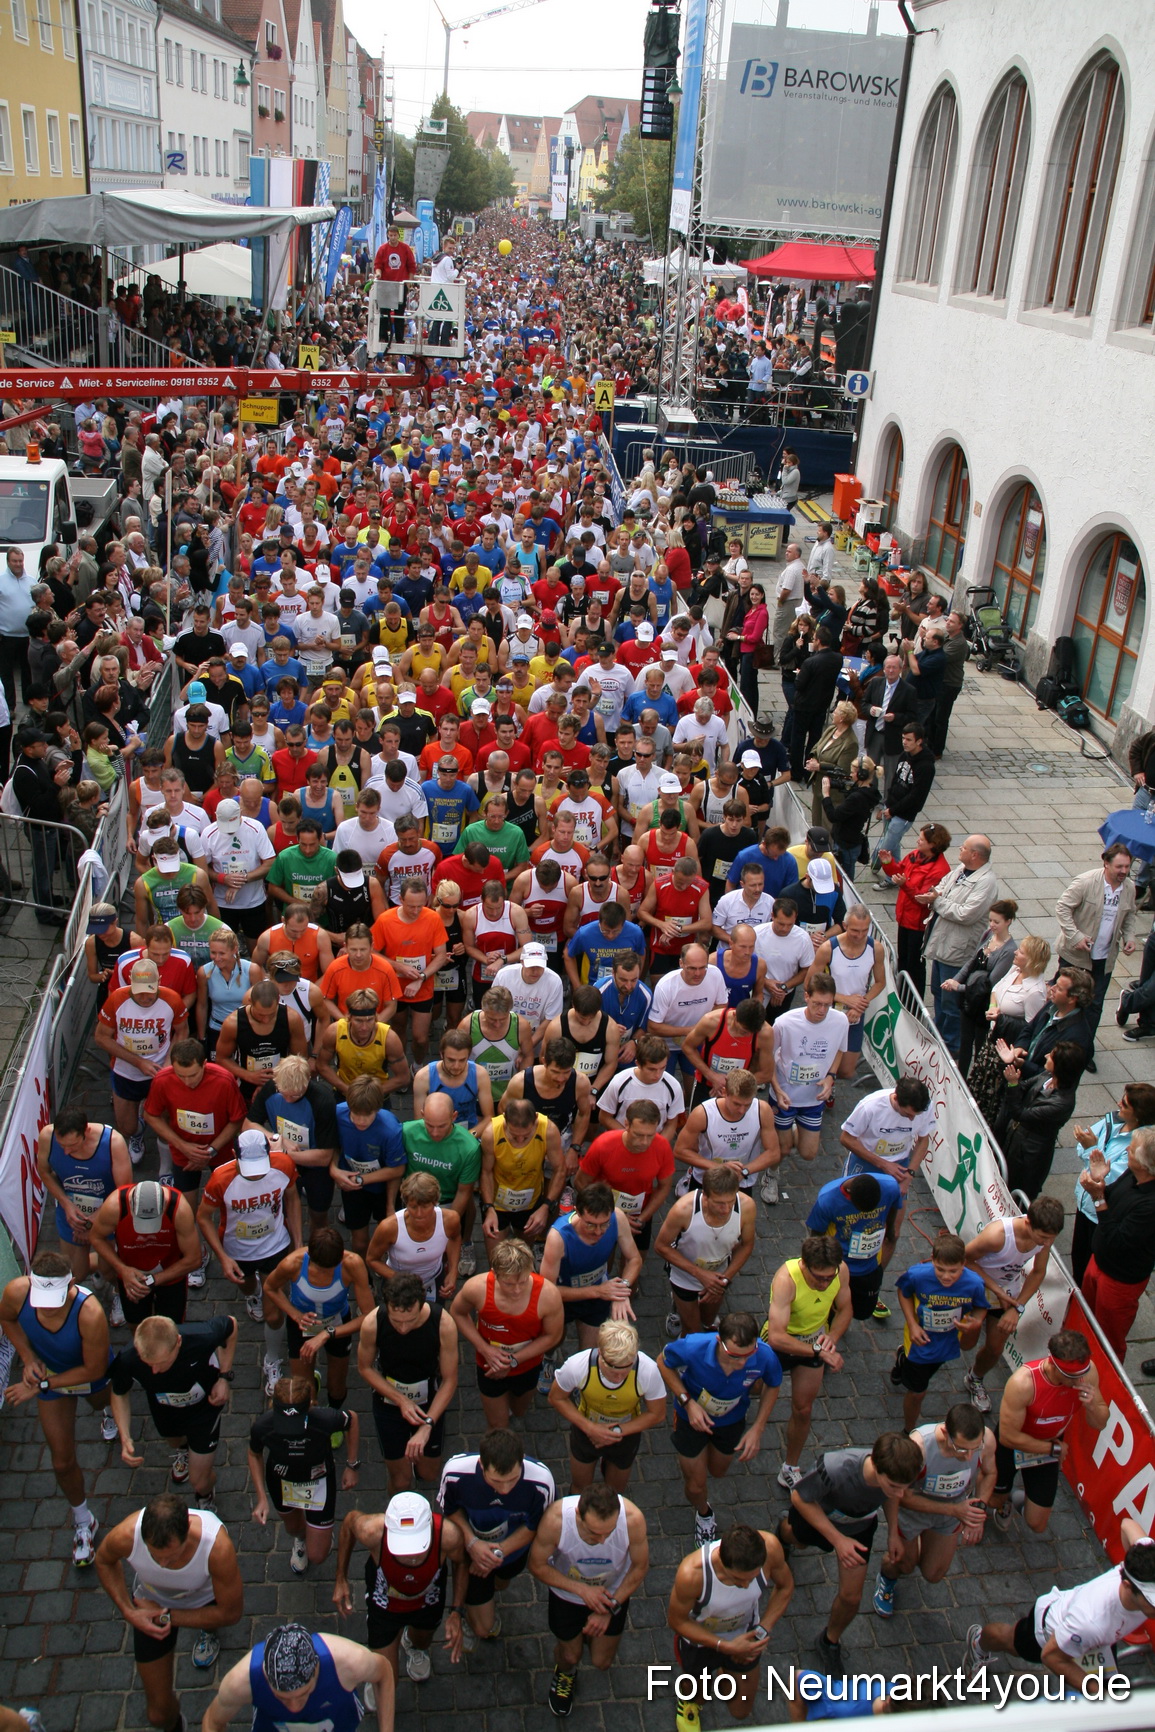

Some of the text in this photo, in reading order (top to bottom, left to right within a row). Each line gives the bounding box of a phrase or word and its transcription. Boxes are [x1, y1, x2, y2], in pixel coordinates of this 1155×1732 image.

[784, 90, 850, 105] Veranstaltungs-
[854, 97, 870, 106] und
[777, 198, 882, 219] www.barowski-ag
[303, 355, 314, 369] A
[16, 378, 55, 388] Service
[78, 377, 219, 388] Miet- & Serviceline: 09181 6352
[311, 379, 331, 387] 6352
[599, 389, 610, 404] A
[242, 402, 276, 411] Schnupper-
[750, 526, 778, 539] Glossner
[1116, 591, 1129, 605] NEU
[574, 811, 595, 822] ERZ
[486, 846, 507, 854] upret
[394, 863, 430, 877] MERZ
[562, 865, 577, 878] RZ
[292, 872, 324, 882] Sinupret
[155, 890, 179, 898] BOC
[180, 940, 210, 948] BOCK
[513, 1001, 541, 1009] 2007
[119, 1017, 166, 1032] MERZ
[119, 1025, 156, 1035] Reisen
[136, 1043, 154, 1051] 504
[488, 1069, 508, 1077] 3264
[799, 1072, 820, 1080] 2156
[190, 1120, 209, 1129] 845
[286, 1131, 303, 1143] 139
[412, 1151, 453, 1171] Sinupret
[231, 1188, 282, 1212] MERZ
[508, 1198, 527, 1206] 237
[621, 1201, 638, 1210] 654
[251, 1225, 270, 1236] 503
[861, 1240, 881, 1251] 2535
[929, 1294, 973, 1304] NEUMARKTER
[173, 1392, 199, 1404] 3477
[407, 1391, 421, 1399] 84
[938, 1480, 965, 1491] 3528
[305, 1490, 312, 1500] 3
[1081, 1652, 1105, 1668] 476
